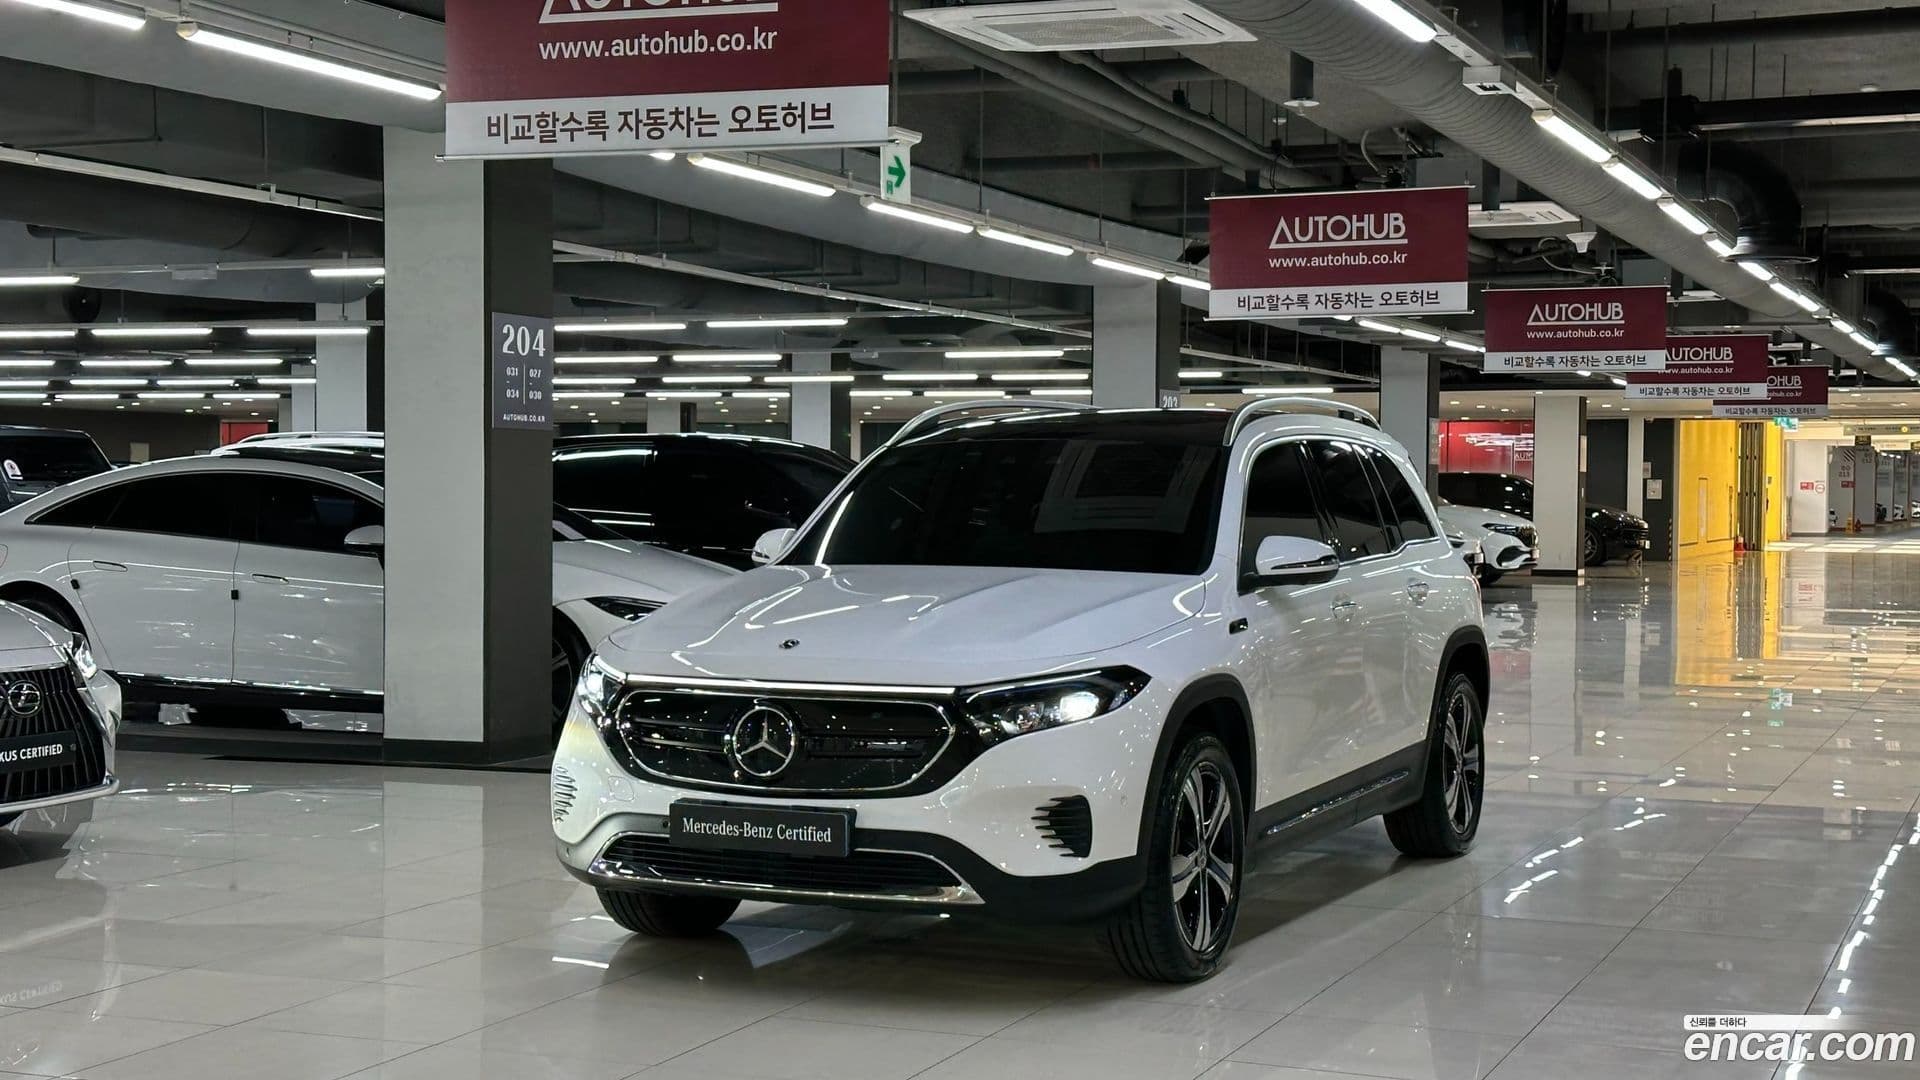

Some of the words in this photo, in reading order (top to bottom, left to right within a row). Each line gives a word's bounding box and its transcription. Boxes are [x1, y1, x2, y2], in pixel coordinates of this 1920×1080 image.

[539, 26, 778, 60] www.autohub.co.kr
[487, 110, 610, 144] 비교할수록
[617, 105, 720, 140] 자동차는
[728, 101, 835, 135] 오토허브
[1269, 212, 1408, 249] AUTOHUB
[1269, 251, 1408, 268] www.autohub.co.kr
[1237, 293, 1310, 312] 비교할수록
[1314, 292, 1374, 310] 자동차는
[1379, 290, 1441, 307] 오토허브
[1527, 302, 1625, 326] AUTOHUB
[502, 324, 546, 357] 204
[1527, 328, 1625, 339] www.autohub.co.kr
[1504, 355, 1556, 368] 비교할수록
[1558, 355, 1601, 368] 자동차는
[1604, 354, 1647, 366] 오토허브
[506, 366, 518, 377] 031
[506, 388, 519, 399] 034
[529, 390, 542, 401] 030
[1639, 386, 1680, 397] 비교할수록
[1682, 385, 1714, 396] 자동차는
[1717, 385, 1751, 396] 오토허브
[20, 744, 63, 759] CERTIFIED
[682, 817, 773, 840] Mercedes-Benz
[777, 824, 832, 843] Certified
